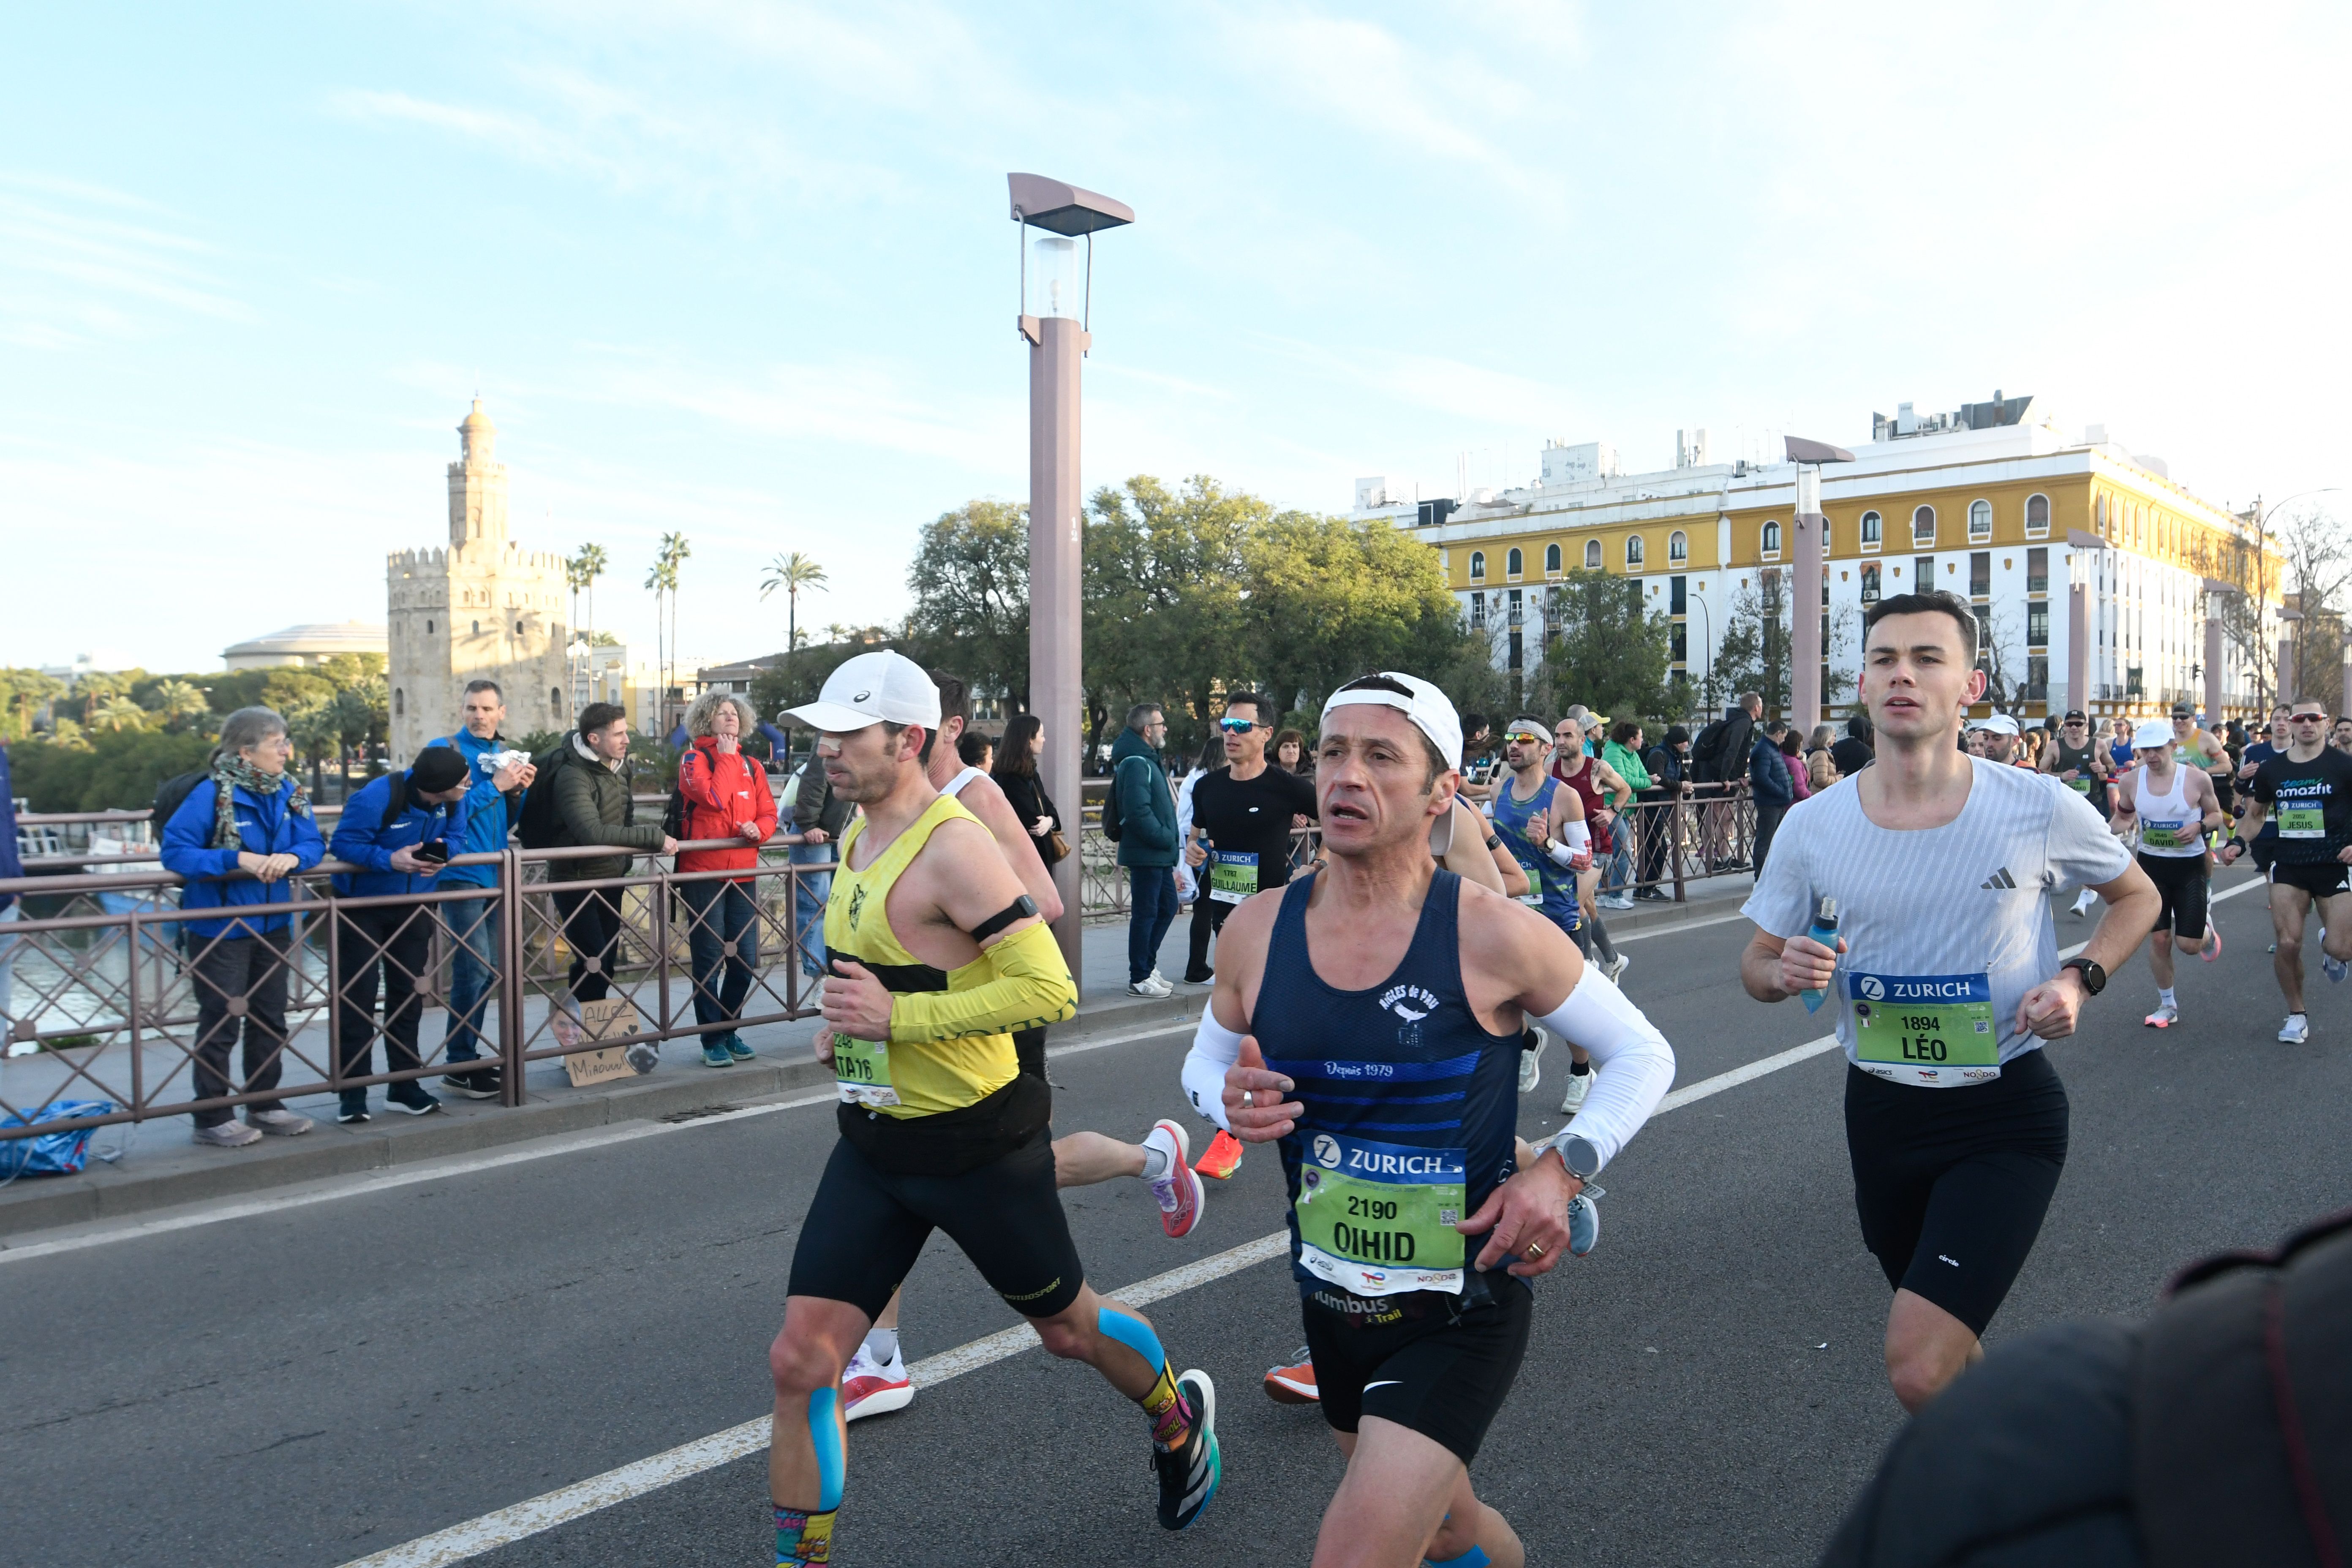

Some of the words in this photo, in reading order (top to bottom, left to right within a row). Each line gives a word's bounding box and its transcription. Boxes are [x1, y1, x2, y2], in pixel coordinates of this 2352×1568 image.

[2276, 782, 2332, 798] amazfit
[2280, 777, 2323, 788] team
[2287, 821, 2313, 829] JESUS
[1222, 854, 1251, 863] ZURICH
[1211, 878, 1257, 893] GUILLAUME
[1893, 982, 1971, 997] ZURICH
[1419, 989, 1440, 1009] PAU
[1901, 1016, 1940, 1031] 1894
[1902, 1033, 1947, 1061] LÉO
[1324, 1061, 1361, 1078] Depuis
[1364, 1064, 1394, 1077] 1979
[1349, 1148, 1442, 1174] ZURICH
[1348, 1196, 1396, 1220] 2190
[1334, 1222, 1415, 1261] OIHID
[1938, 1255, 1959, 1267] circle
[1374, 1309, 1402, 1323] Trail
